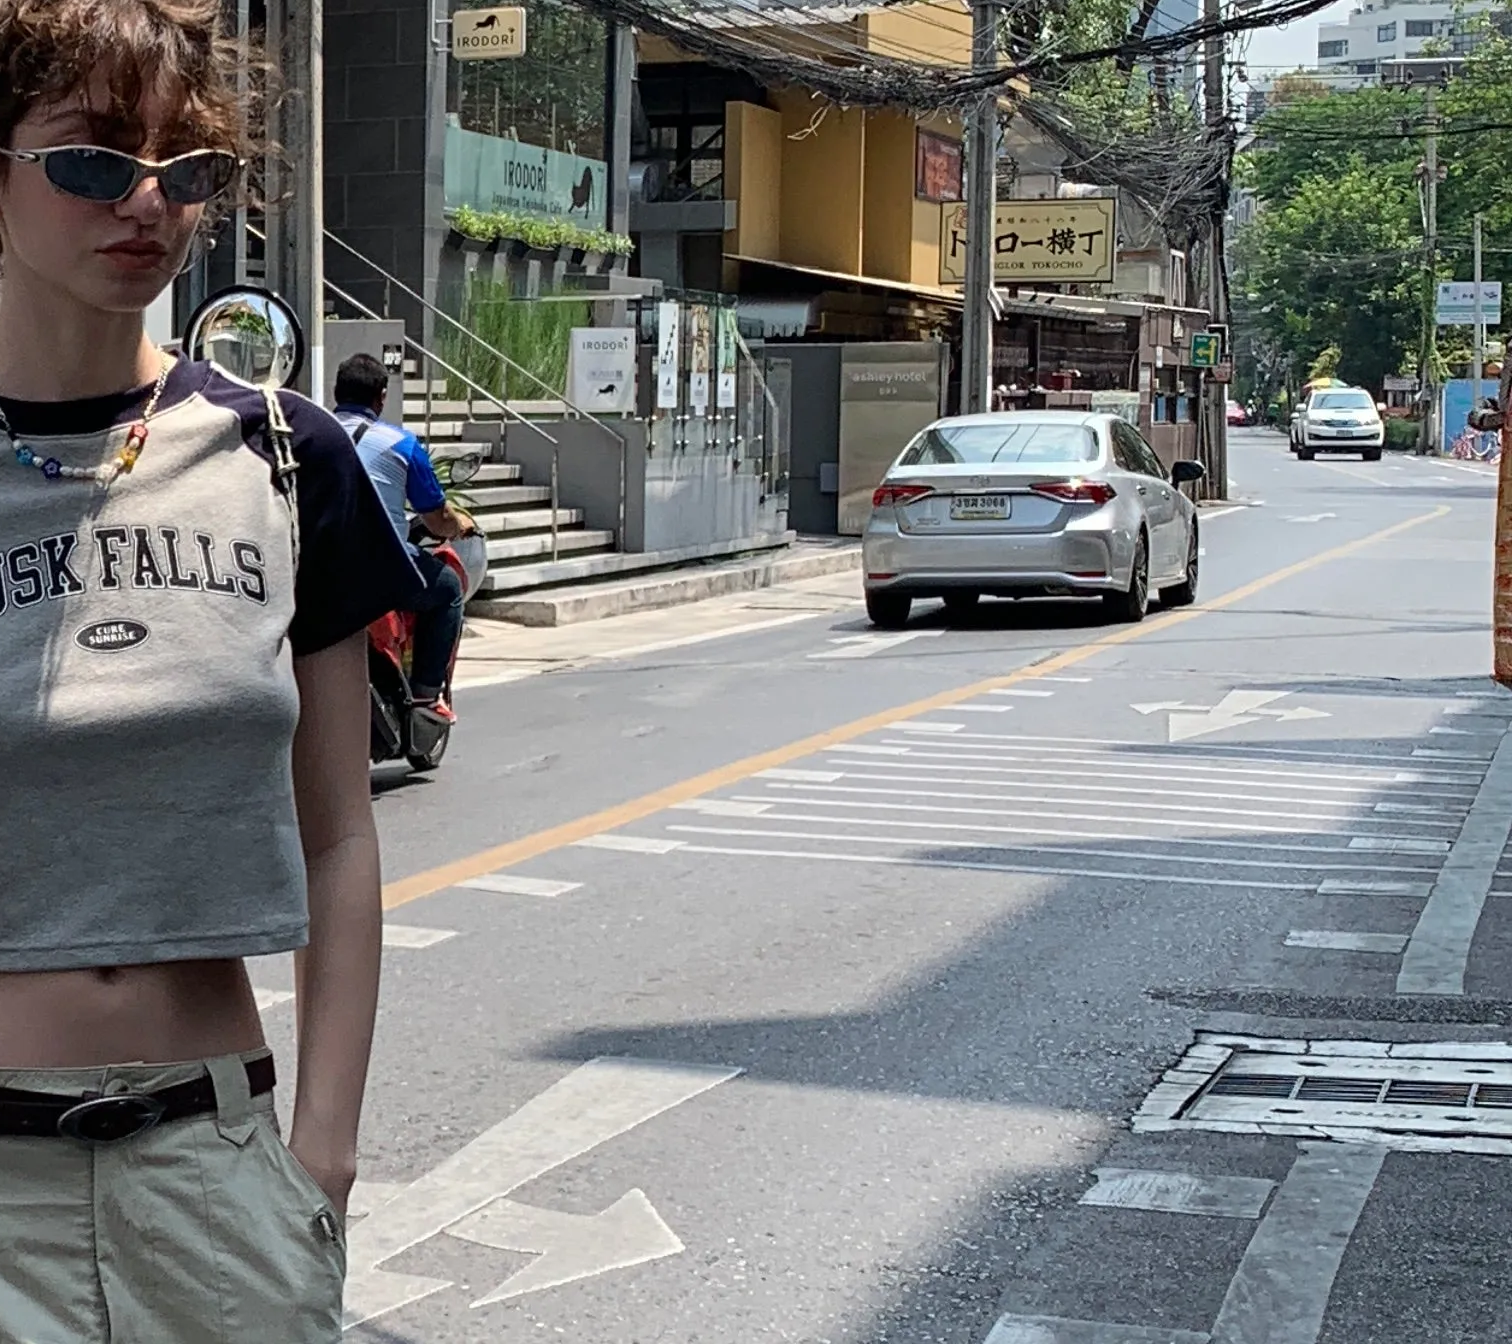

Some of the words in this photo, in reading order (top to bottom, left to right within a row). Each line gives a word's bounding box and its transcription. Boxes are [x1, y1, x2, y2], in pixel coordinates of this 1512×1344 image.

[951, 227, 1104, 257] トロー横丁
[93, 525, 269, 606] FALLS
[88, 630, 137, 645] SUNRISE
